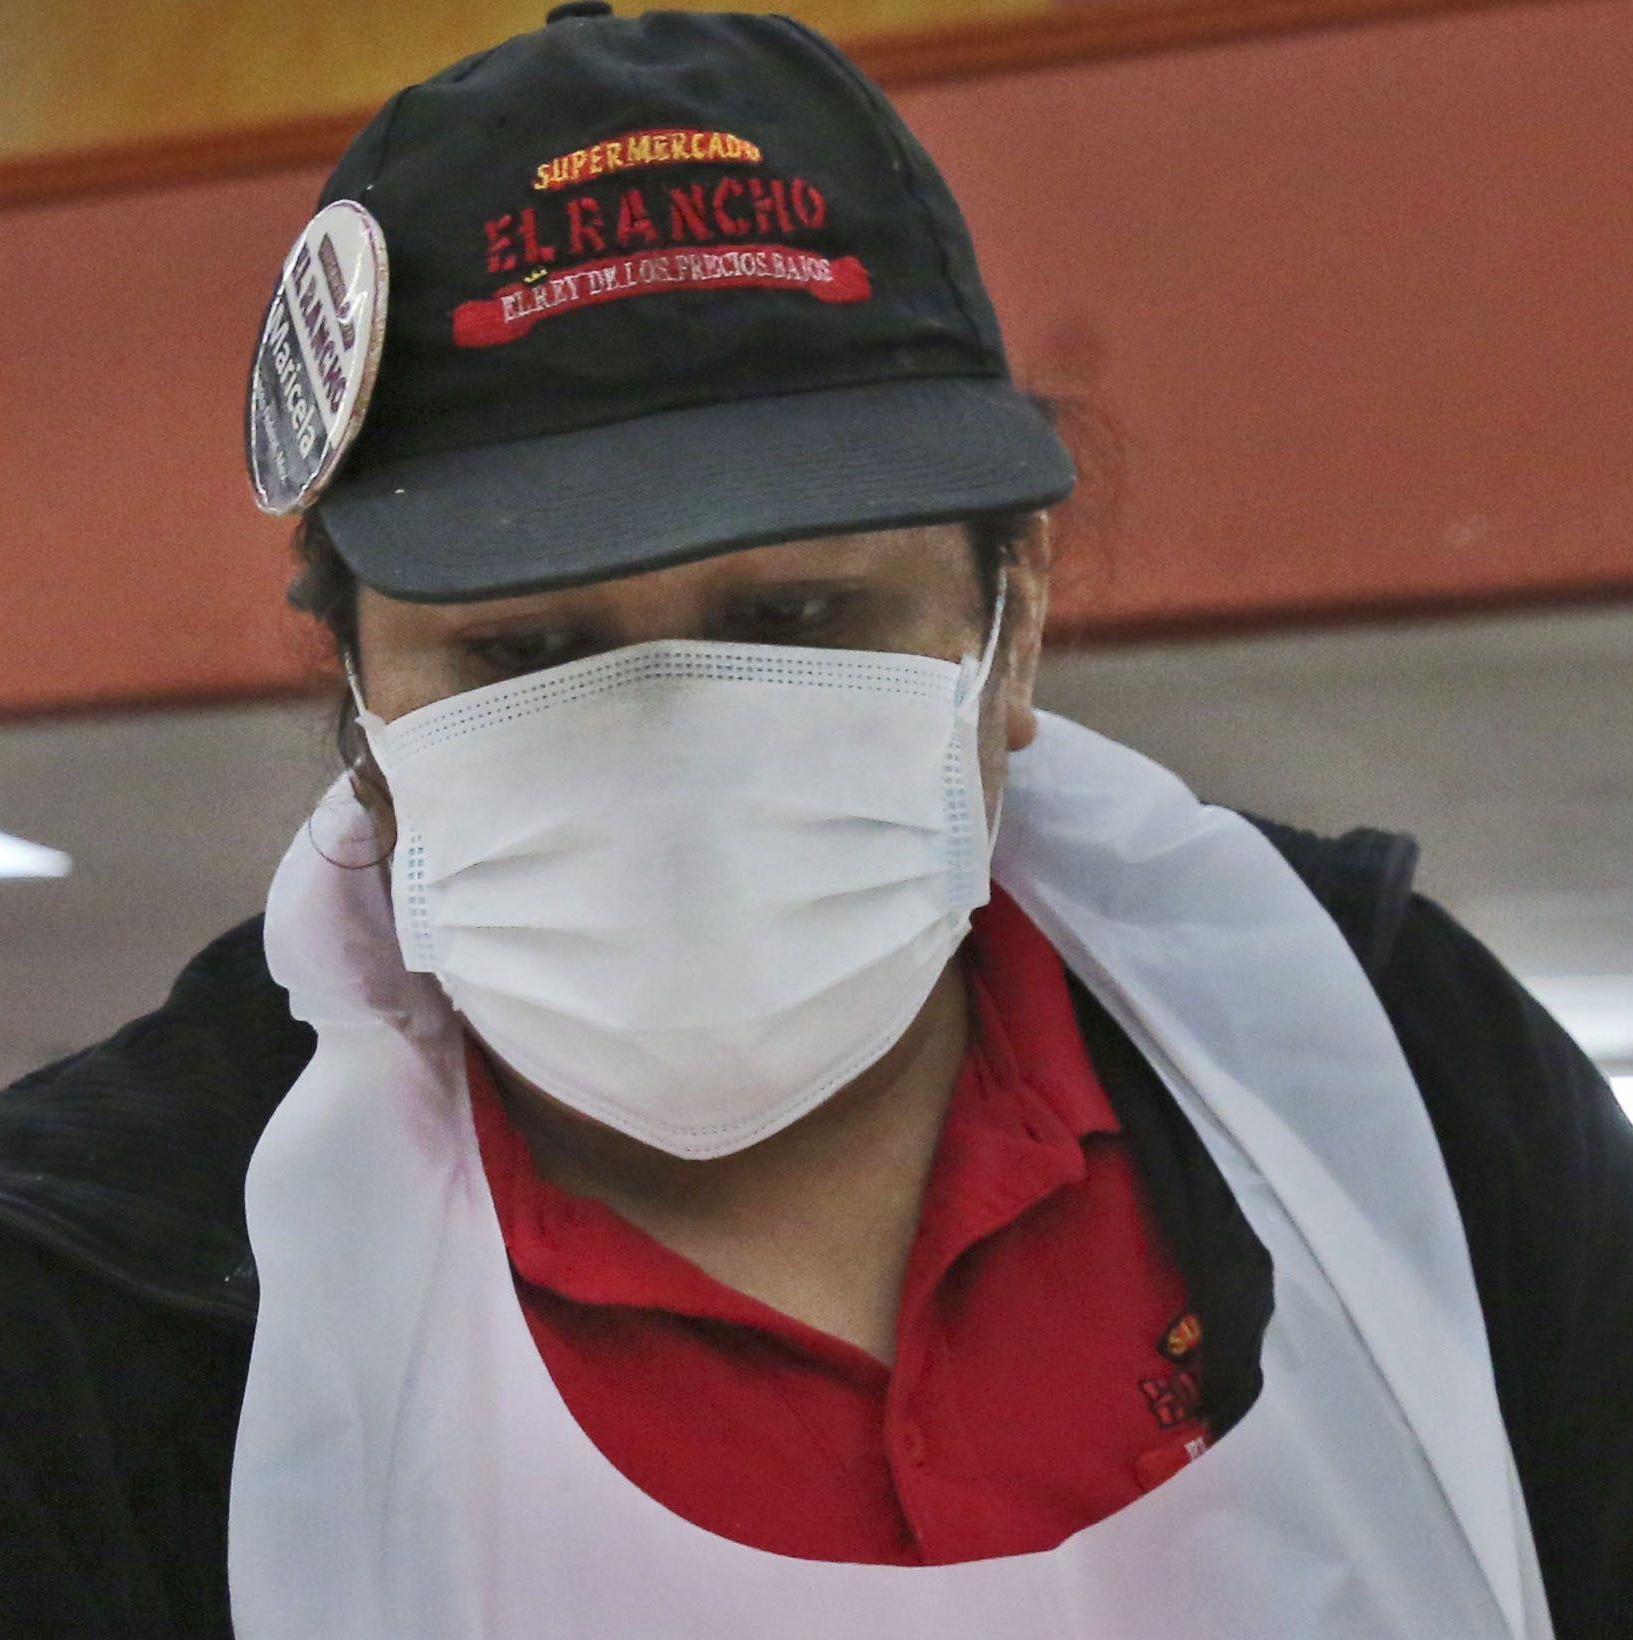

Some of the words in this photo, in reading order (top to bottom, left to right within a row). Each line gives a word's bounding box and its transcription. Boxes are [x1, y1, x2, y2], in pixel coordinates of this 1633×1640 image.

[533, 132, 762, 191] SUPERMERCADO
[484, 207, 555, 273] EL
[566, 176, 826, 255] RANCHO
[500, 290, 530, 322] EL
[531, 275, 579, 309] REY
[588, 265, 619, 296] DE
[675, 251, 767, 281] PRECIOS
[266, 302, 317, 460] Maricela
[298, 275, 348, 414] RANCHO
